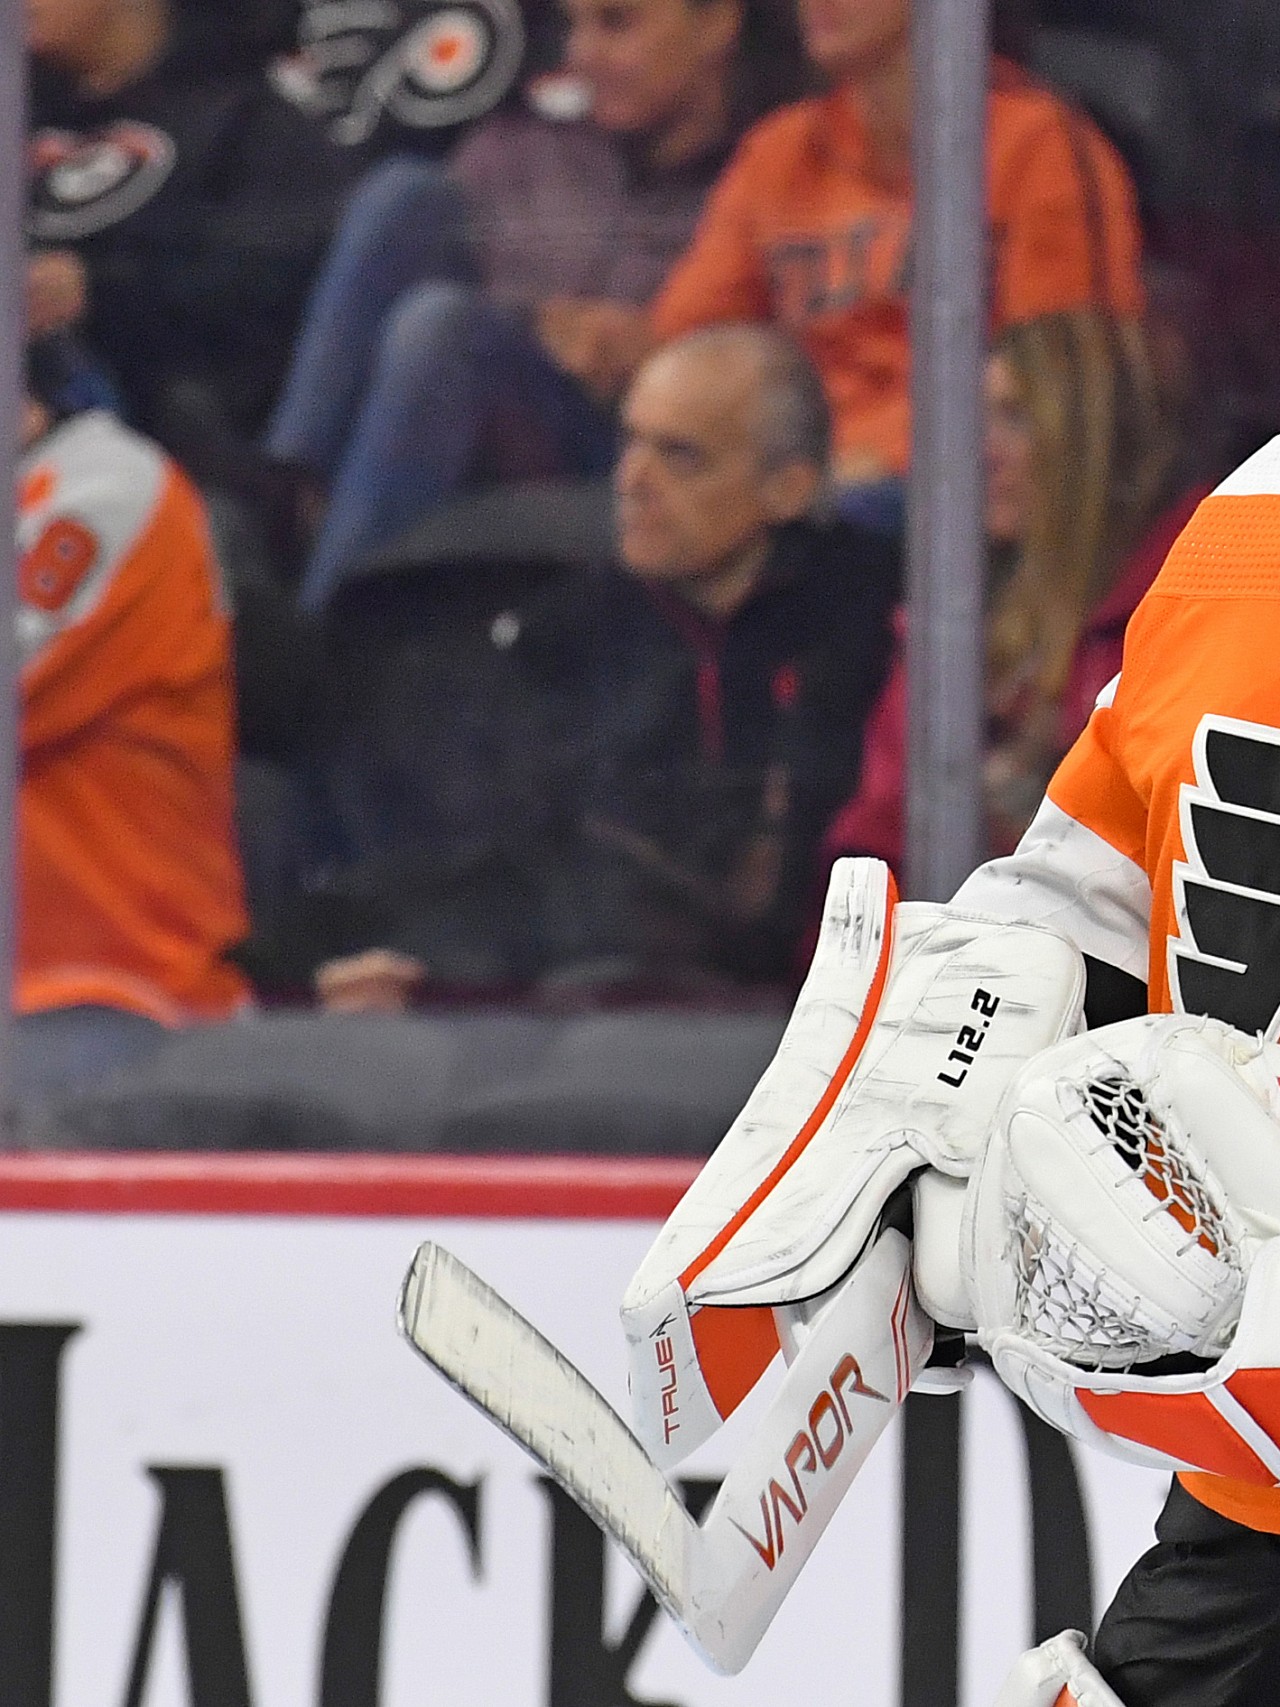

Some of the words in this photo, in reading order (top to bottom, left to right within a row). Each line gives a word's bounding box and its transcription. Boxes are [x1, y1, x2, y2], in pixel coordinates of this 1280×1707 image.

[936, 988, 1001, 1089] L12.2
[655, 1336, 680, 1445] TRUE
[727, 1352, 891, 1572] VAPOR
